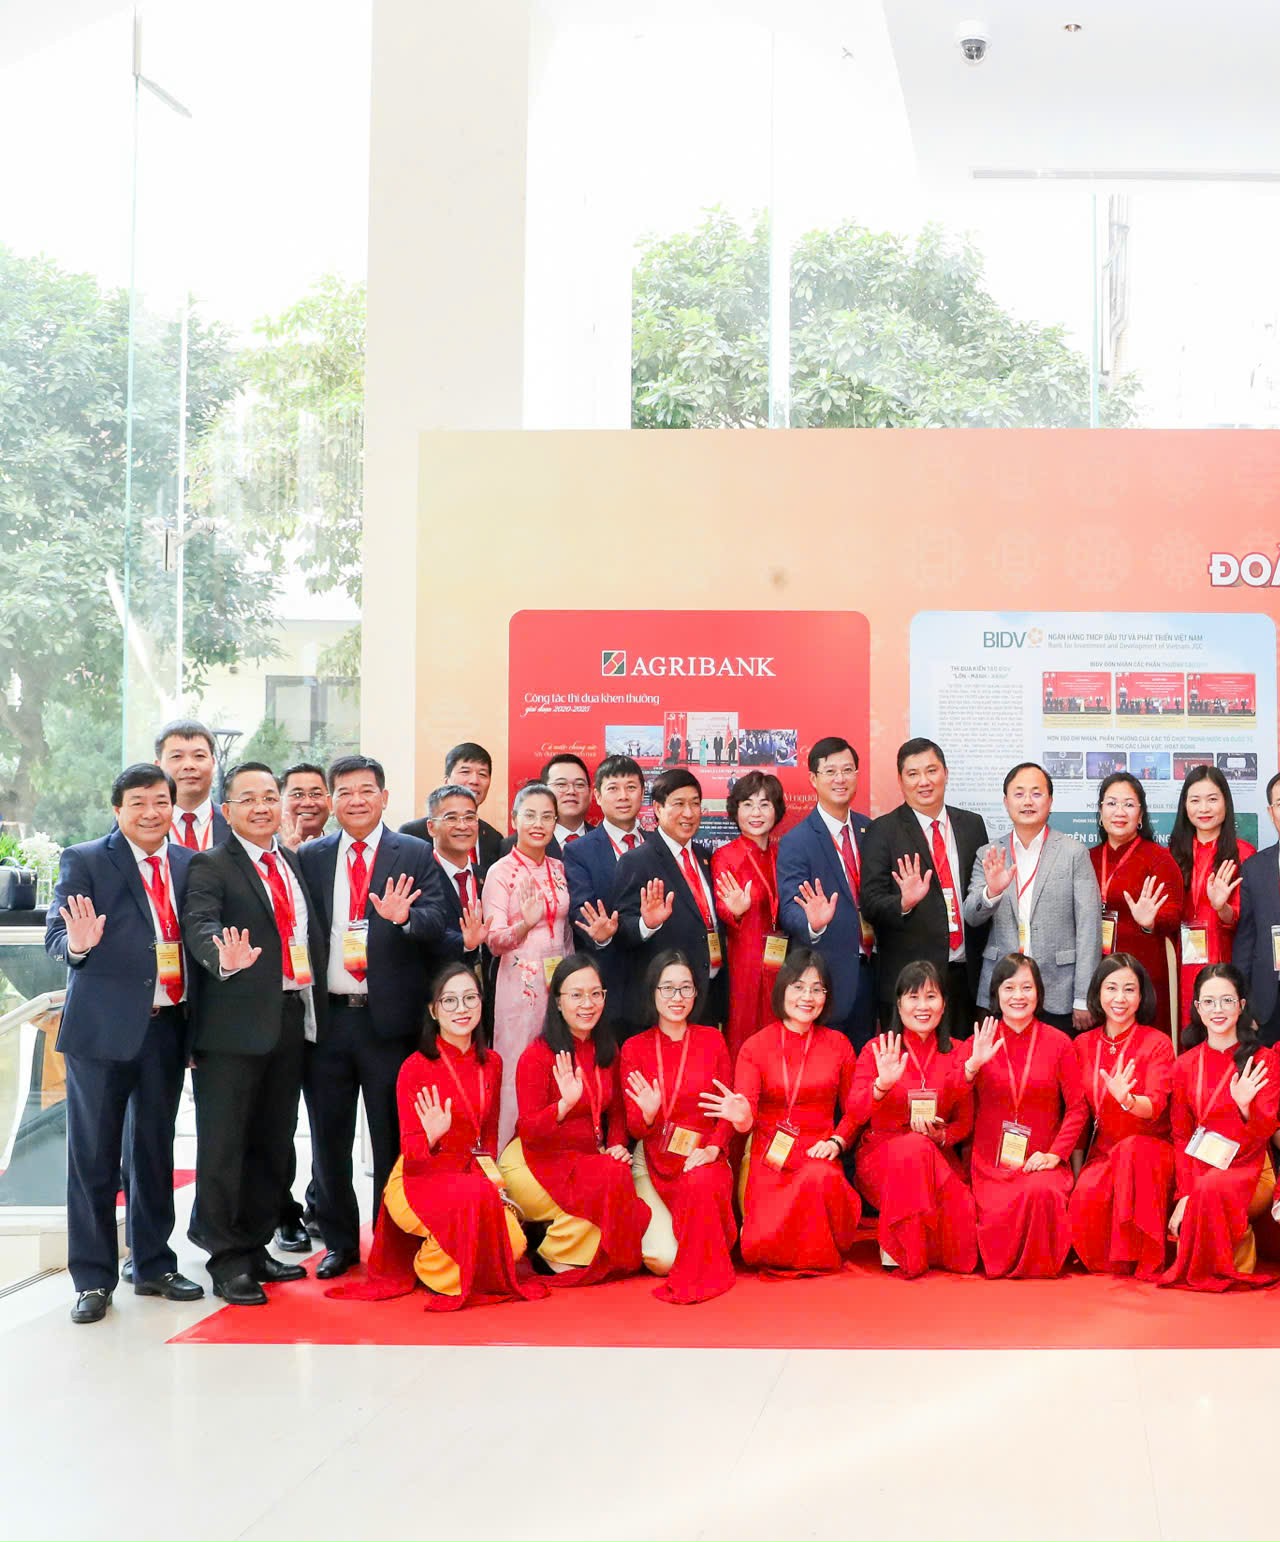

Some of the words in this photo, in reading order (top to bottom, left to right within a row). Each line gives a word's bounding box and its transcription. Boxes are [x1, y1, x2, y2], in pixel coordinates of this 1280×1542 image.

[983, 631, 1027, 648] BIDV
[630, 656, 776, 677] AGRIBANK
[524, 693, 550, 705] Công
[551, 693, 567, 703] tác
[568, 693, 580, 703] thi
[600, 693, 624, 703] khen
